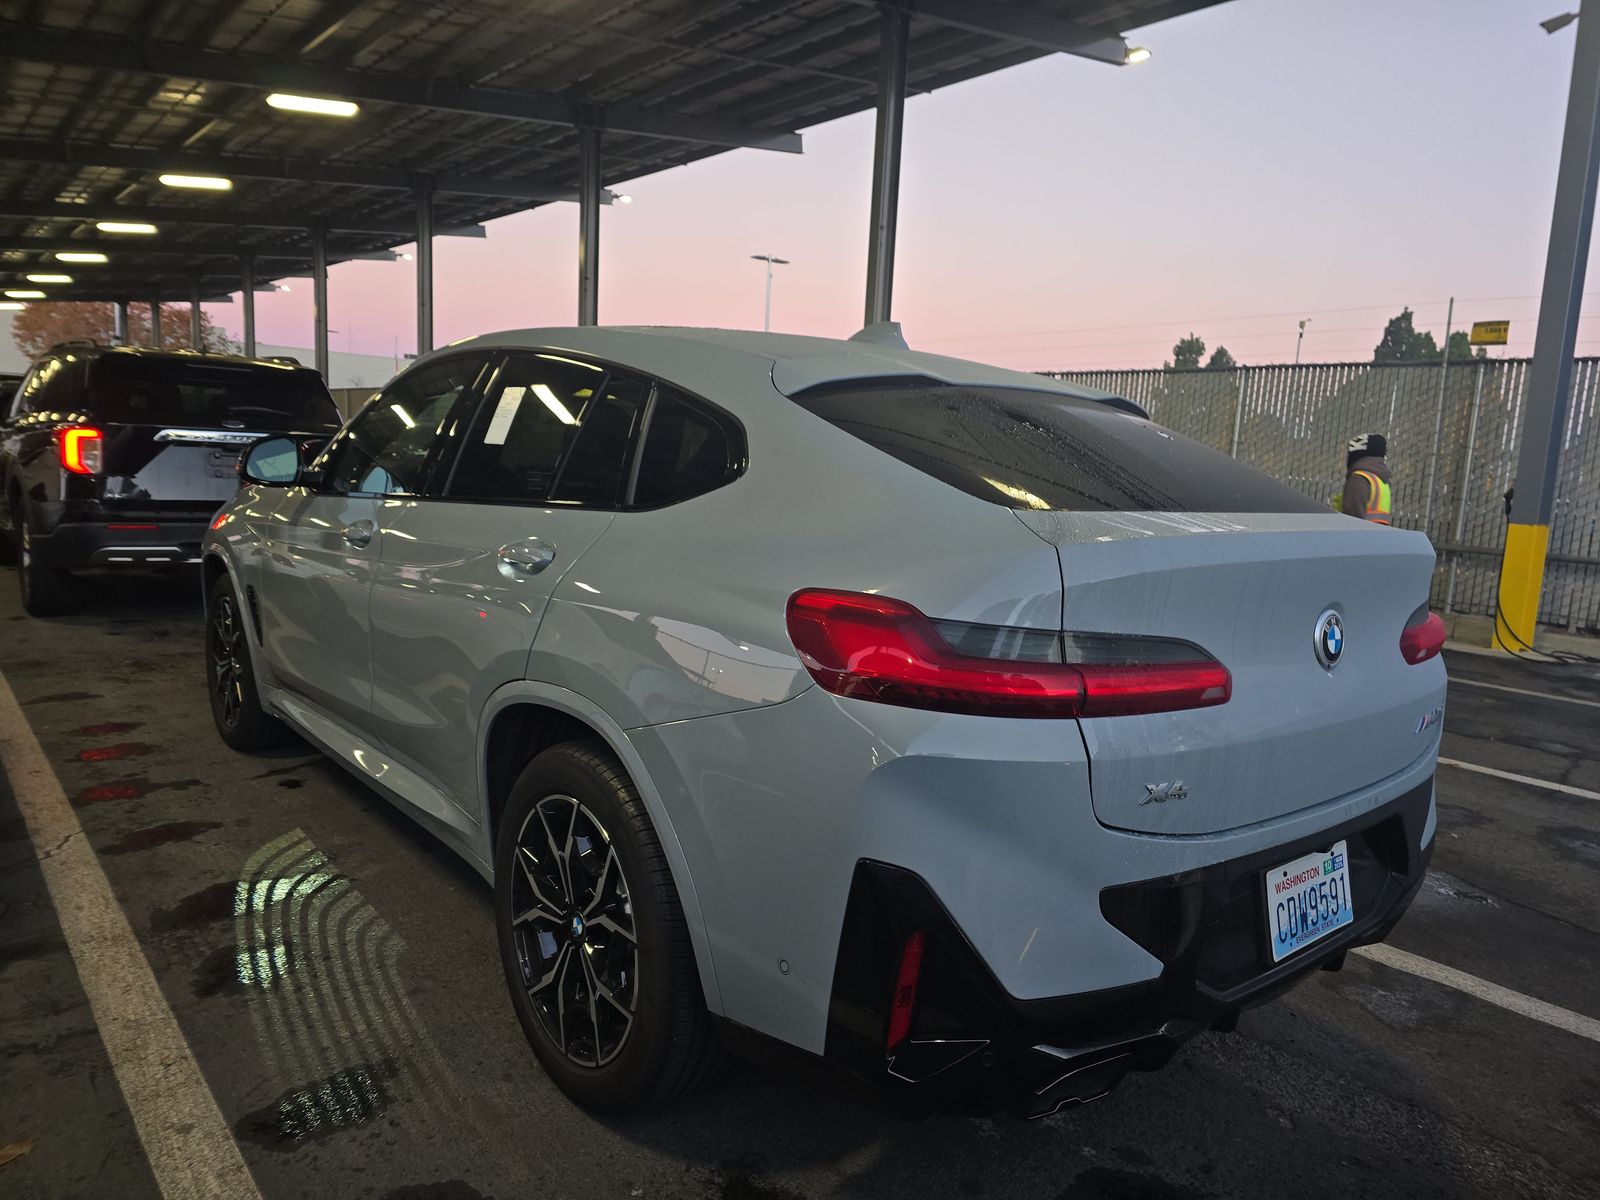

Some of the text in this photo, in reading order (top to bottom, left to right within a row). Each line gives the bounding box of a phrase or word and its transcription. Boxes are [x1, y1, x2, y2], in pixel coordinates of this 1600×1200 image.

[1137, 780, 1188, 806] X4
[1324, 860, 1332, 871] 10
[1275, 866, 1320, 894] WASHINGTON
[1276, 872, 1347, 943] CDW9591
